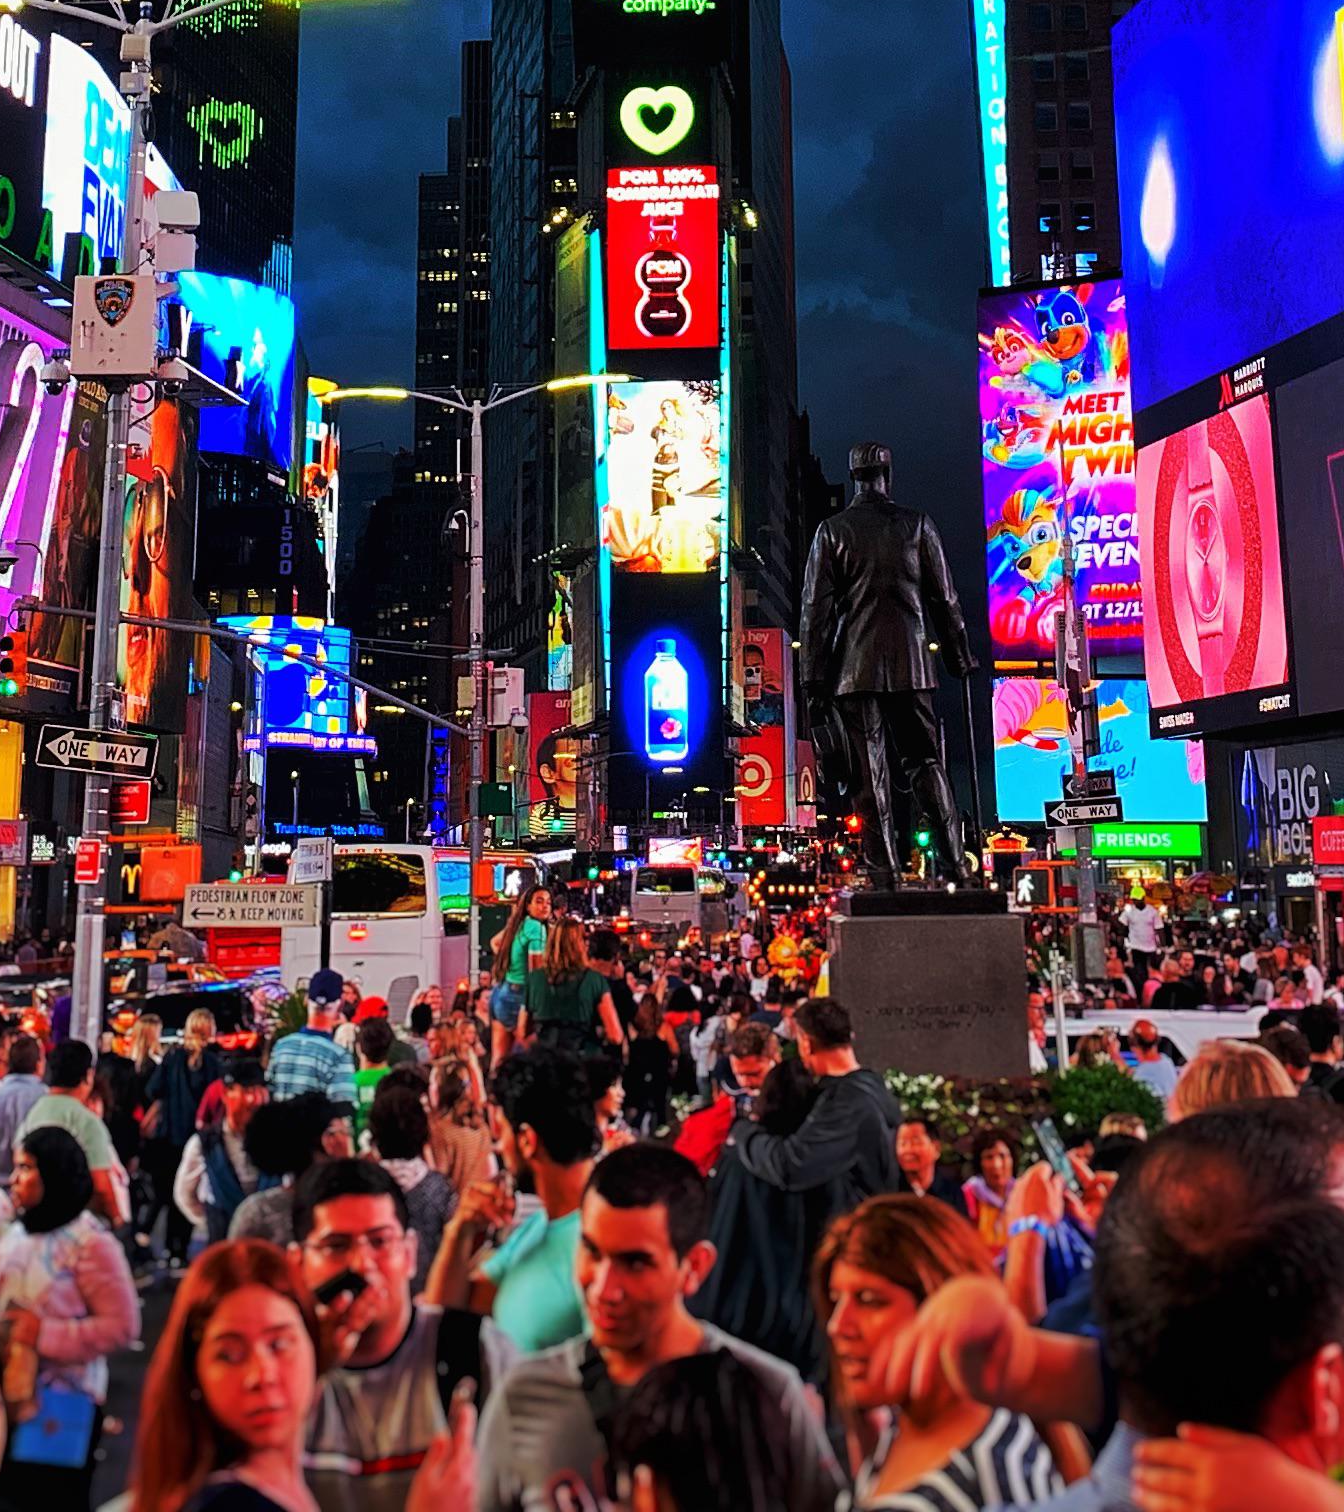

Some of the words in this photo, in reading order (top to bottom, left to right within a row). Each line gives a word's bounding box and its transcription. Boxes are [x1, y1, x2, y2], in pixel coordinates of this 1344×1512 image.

[619, 169, 658, 185] POM
[1063, 391, 1125, 416] MEET
[1044, 413, 1135, 454] MIGH
[278, 508, 293, 576] 1500
[1075, 540, 1141, 570] EVEN
[58, 739, 90, 758] ONE
[105, 744, 141, 764] WAY
[1277, 763, 1321, 821] BIG
[1057, 807, 1080, 820] ONE
[1089, 805, 1113, 817] WAY
[33, 842, 54, 851] POLO
[1095, 833, 1172, 848] FRIENDS
[190, 889, 249, 904] PEDESTRIAN
[251, 890, 277, 904] FLOW
[279, 890, 305, 904] ZONE
[240, 907, 265, 921] KEEP
[268, 907, 305, 921] MOVING
